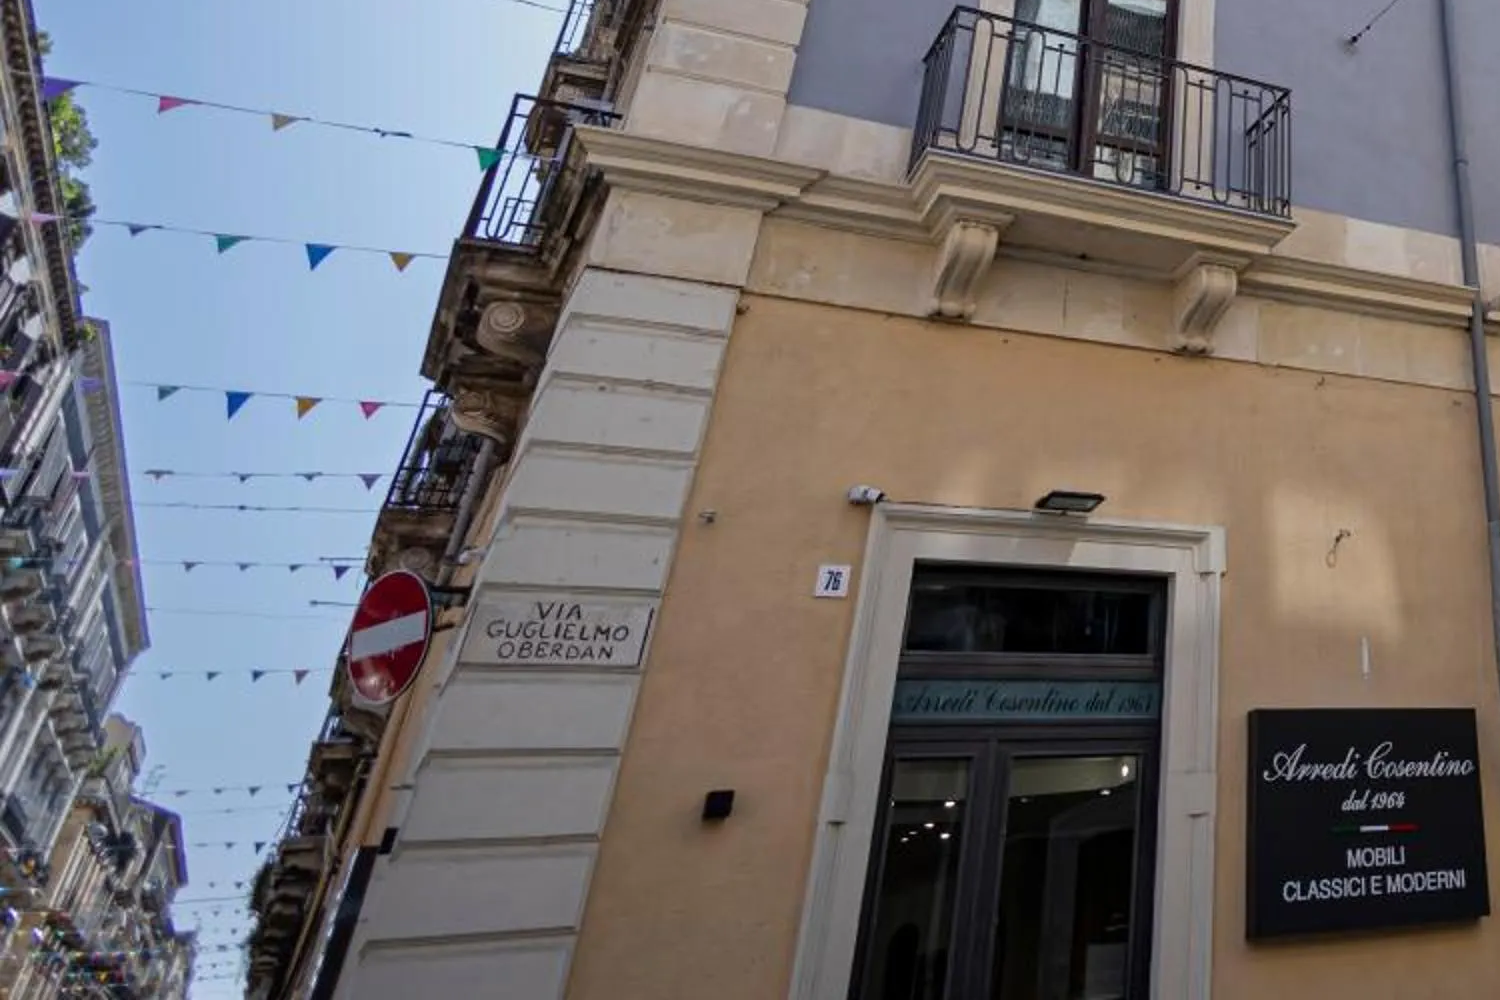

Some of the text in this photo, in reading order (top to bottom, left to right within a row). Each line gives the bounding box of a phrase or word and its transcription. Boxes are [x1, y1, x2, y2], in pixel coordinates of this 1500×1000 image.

[823, 570, 843, 591] 76
[537, 602, 582, 620] VIA
[486, 619, 630, 641] GUGLIELMO
[497, 641, 615, 660] OBERDAN
[1263, 741, 1475, 781] Arredi Cosentino
[1341, 789, 1406, 811] dal 1964
[1346, 845, 1406, 868] MOBILI
[1283, 869, 1466, 901] CLASSICI E MODERNI
